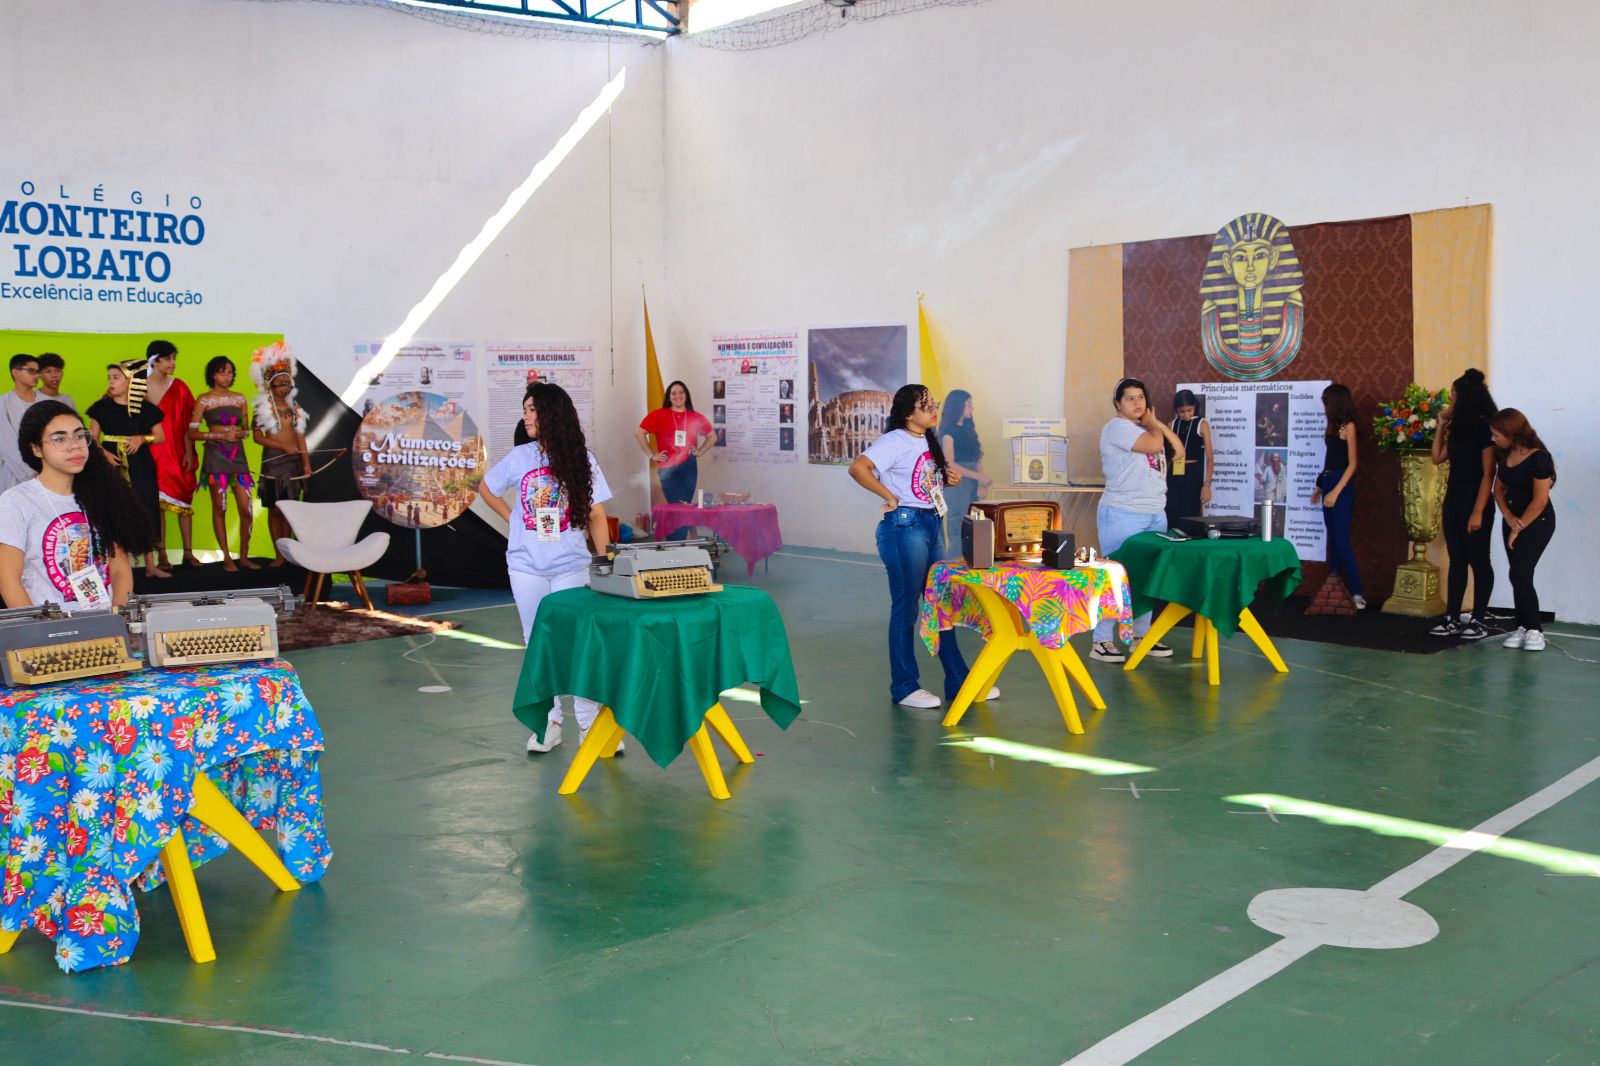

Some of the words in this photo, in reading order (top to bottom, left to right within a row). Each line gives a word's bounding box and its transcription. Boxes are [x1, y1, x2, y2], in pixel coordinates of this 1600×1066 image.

[0, 200, 205, 246] MONTEIRO
[13, 244, 171, 283] LOBATO
[1, 283, 93, 301] Excelência
[98, 288, 122, 302] em
[127, 287, 203, 308] Educação
[1201, 383, 1239, 393] Principais
[1241, 382, 1293, 391] matemáticos
[362, 451, 372, 462] e
[377, 448, 477, 470] civilizações
